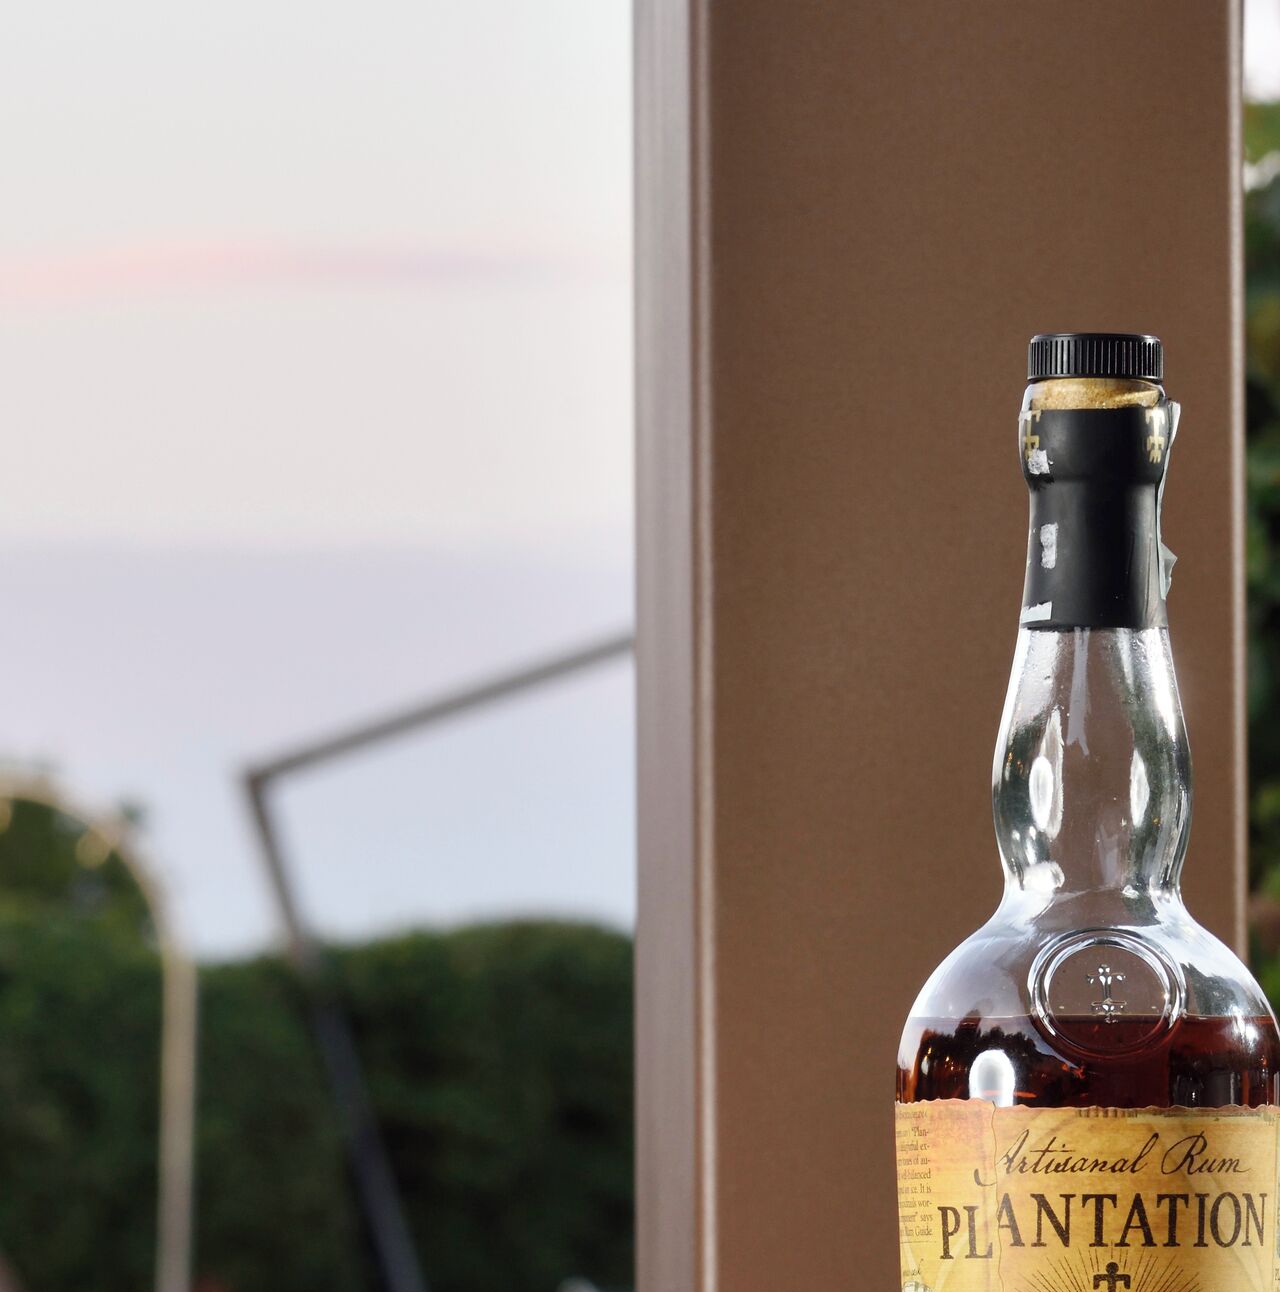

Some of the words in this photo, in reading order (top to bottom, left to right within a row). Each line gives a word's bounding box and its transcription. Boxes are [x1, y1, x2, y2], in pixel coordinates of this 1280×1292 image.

[974, 1128, 1158, 1187] Artisanal
[1161, 1130, 1253, 1175] Rum
[937, 1192, 1268, 1260] PLANTATION
